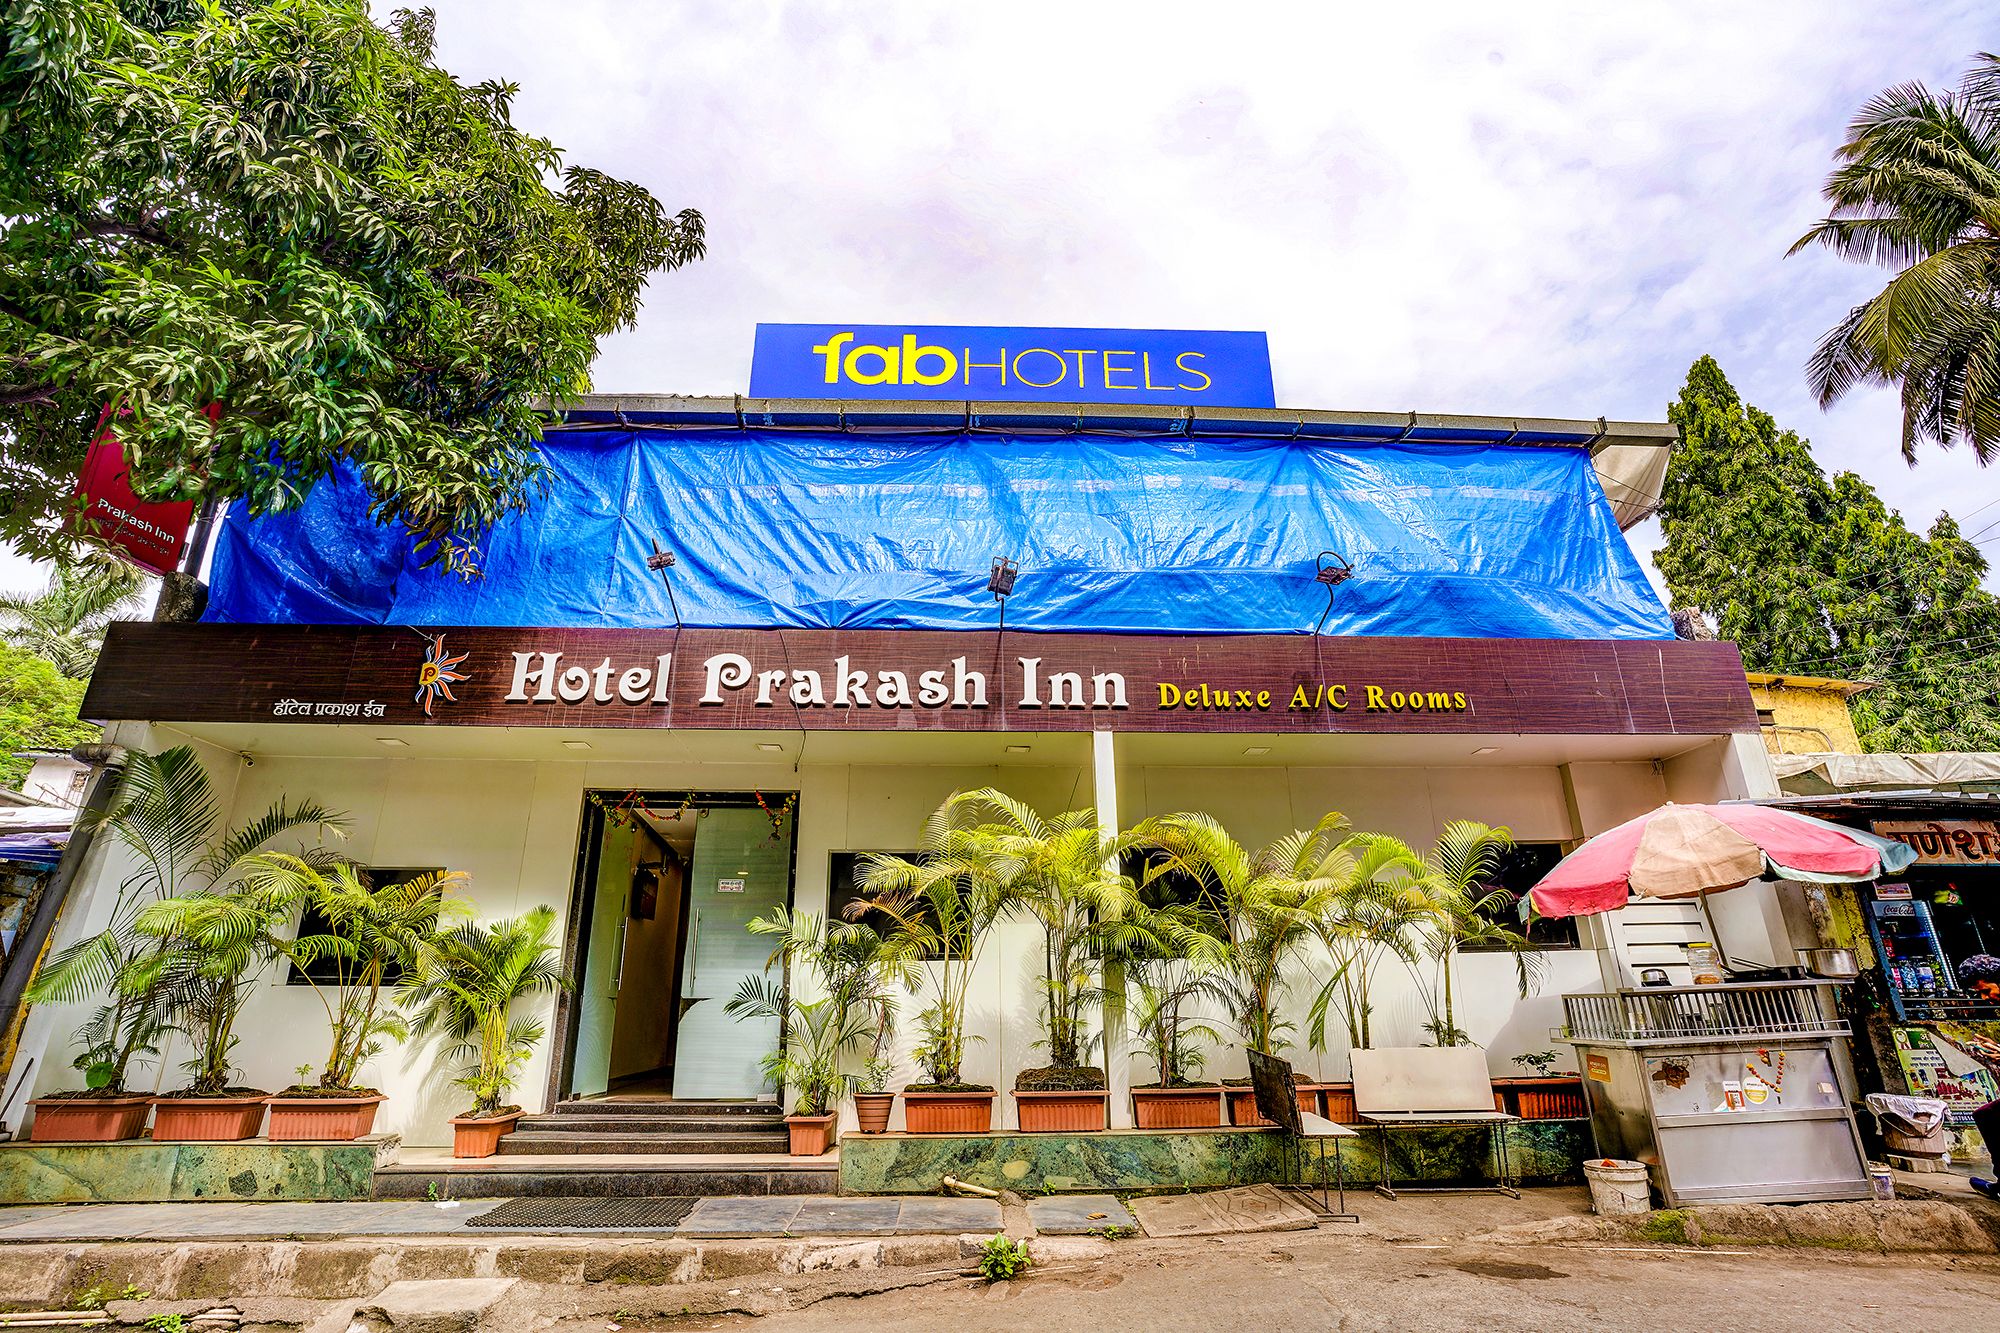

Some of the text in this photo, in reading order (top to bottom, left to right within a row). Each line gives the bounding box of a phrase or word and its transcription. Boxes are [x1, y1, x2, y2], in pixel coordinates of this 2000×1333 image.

[97, 498, 153, 533] Prakash
[155, 526, 175, 544] Inn
[504, 651, 1130, 709] Hotel Prakash Inn
[1157, 682, 1468, 710] Deluxe A/C Rooms
[273, 698, 387, 718] हॉटेल प्रकाश ईन
